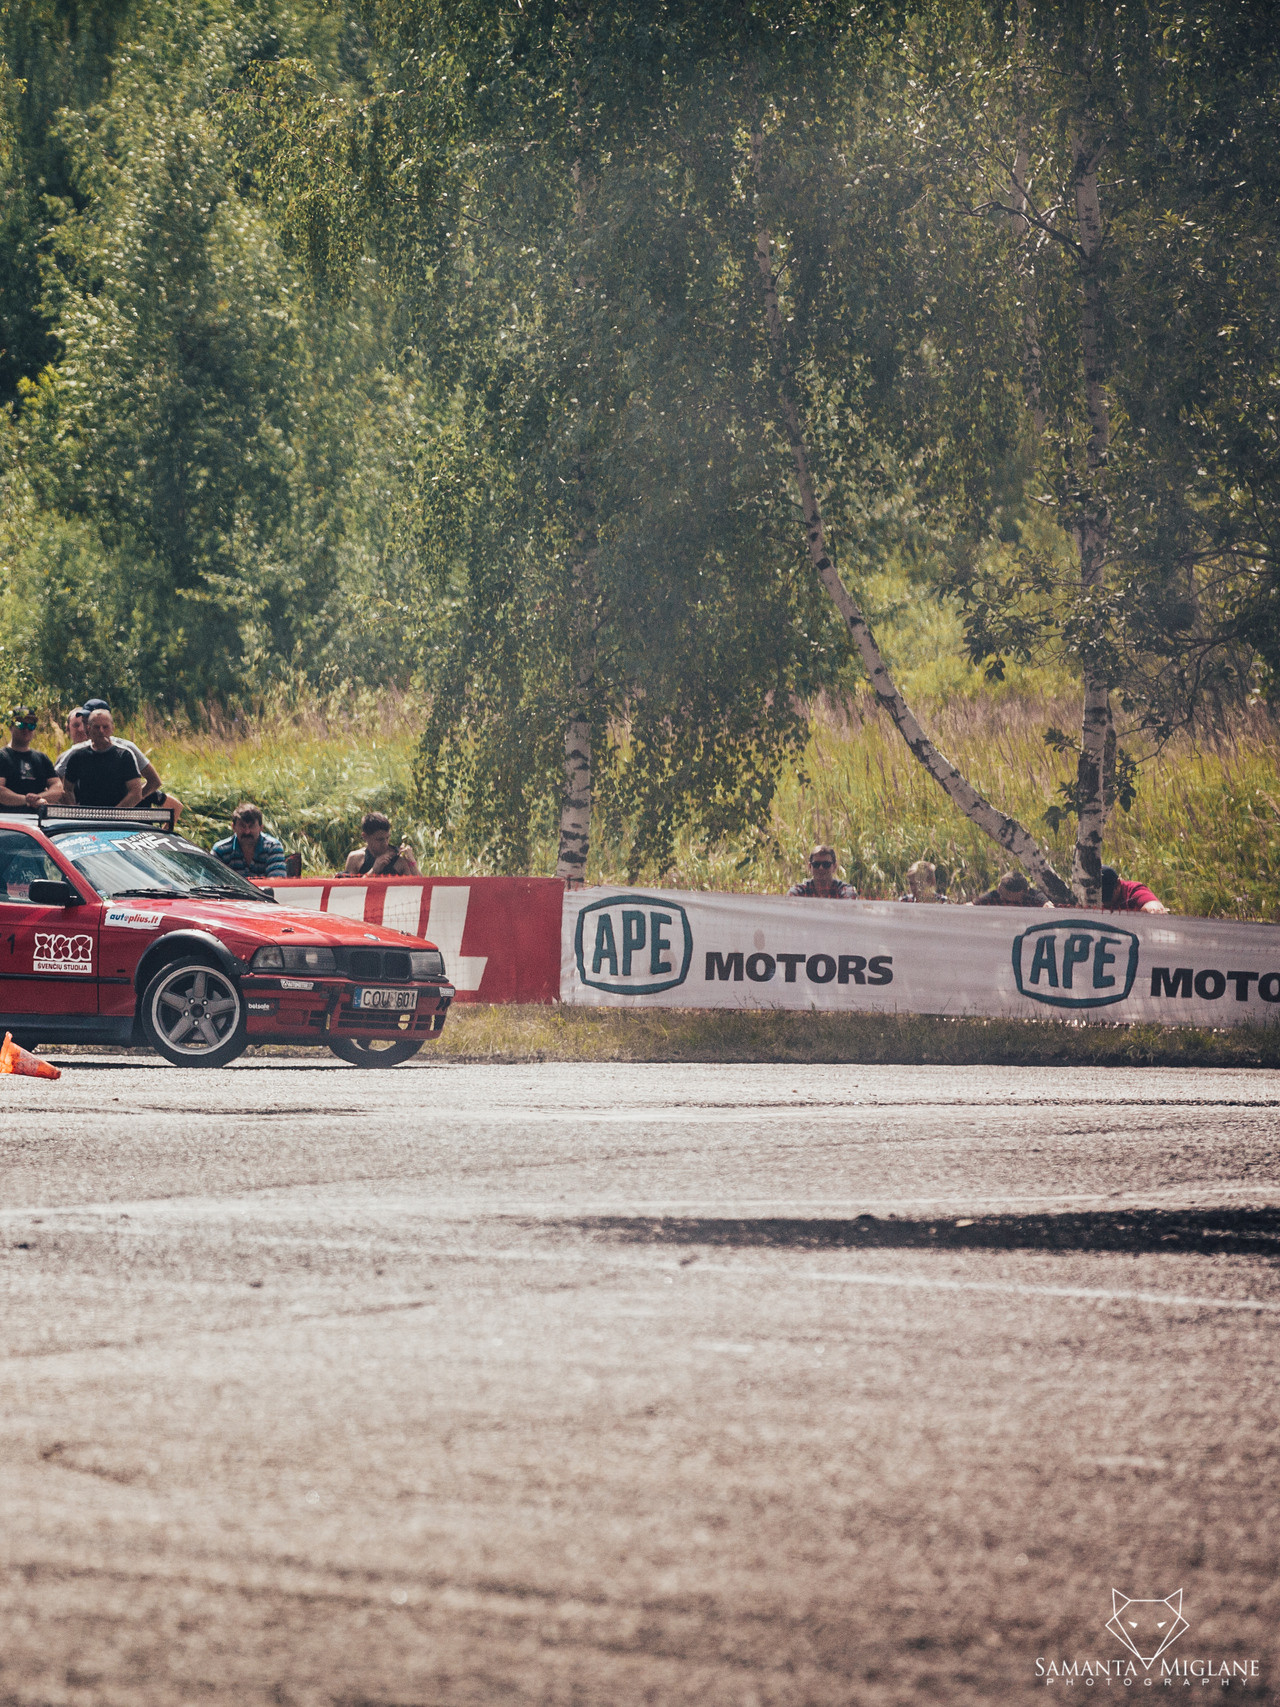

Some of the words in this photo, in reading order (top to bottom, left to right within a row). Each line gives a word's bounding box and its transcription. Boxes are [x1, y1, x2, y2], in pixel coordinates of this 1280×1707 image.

[7, 933, 16, 955] 1
[592, 910, 673, 976] APE
[704, 951, 894, 986] MOTORS
[63, 962, 88, 972] STUDIJA
[1029, 934, 1122, 989] APE
[396, 991, 416, 1008] 601
